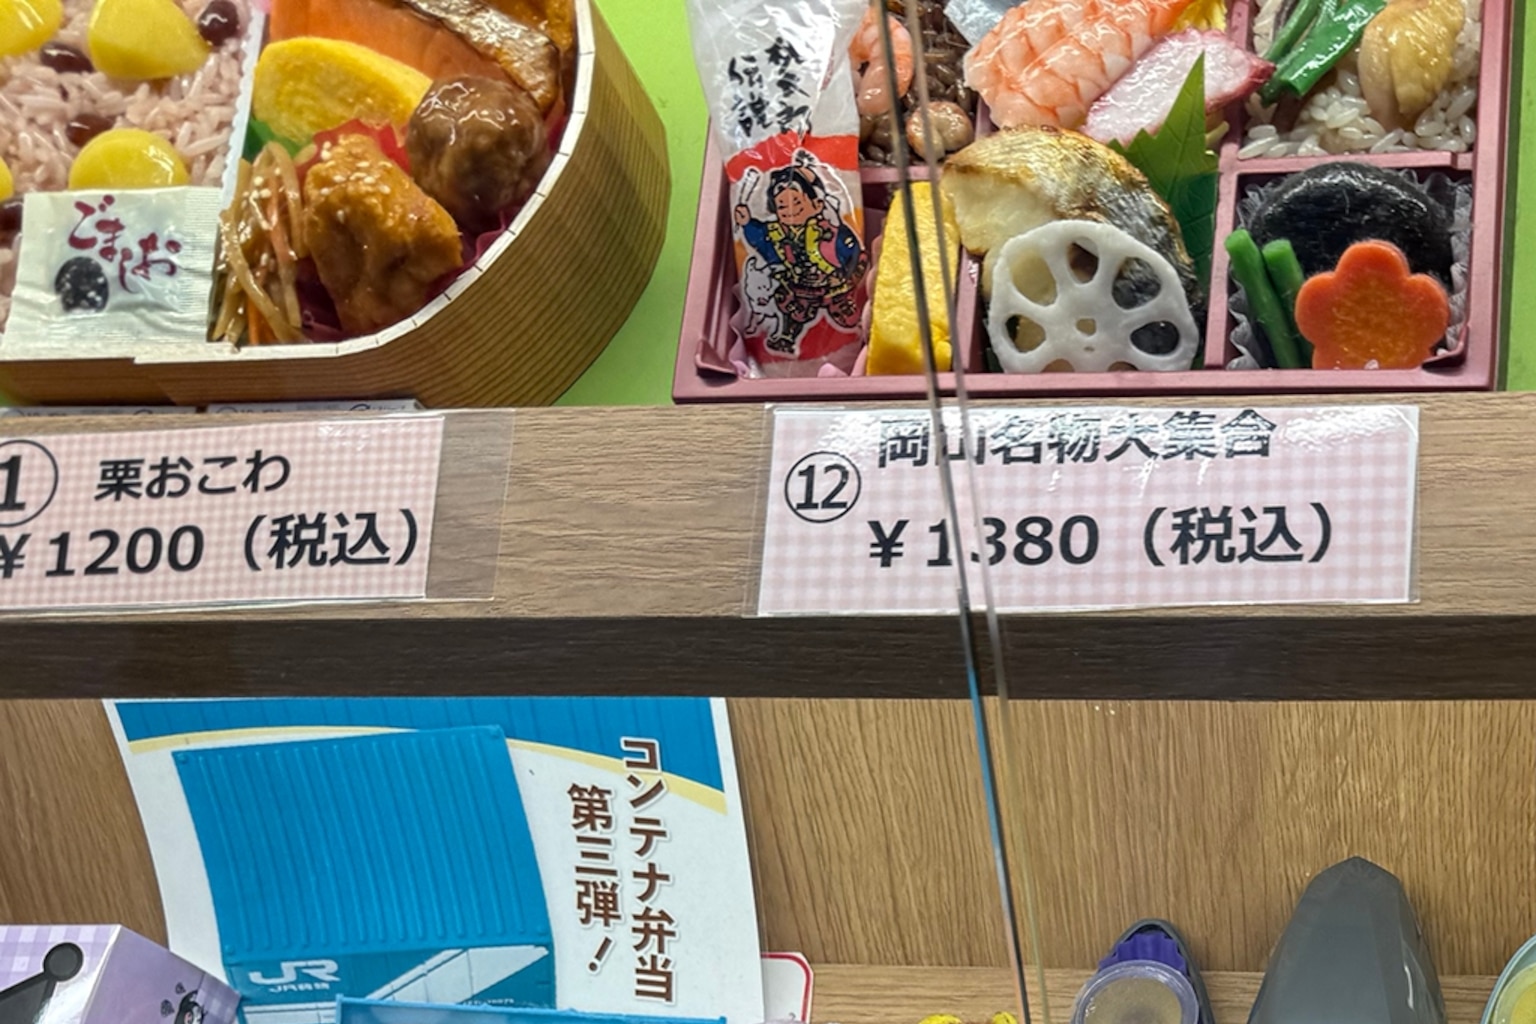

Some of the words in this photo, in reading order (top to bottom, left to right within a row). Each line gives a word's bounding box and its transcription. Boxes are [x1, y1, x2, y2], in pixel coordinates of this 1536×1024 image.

[94, 449, 291, 501] 栗おこわ
[620, 736, 678, 1003] コンテナ弁当
